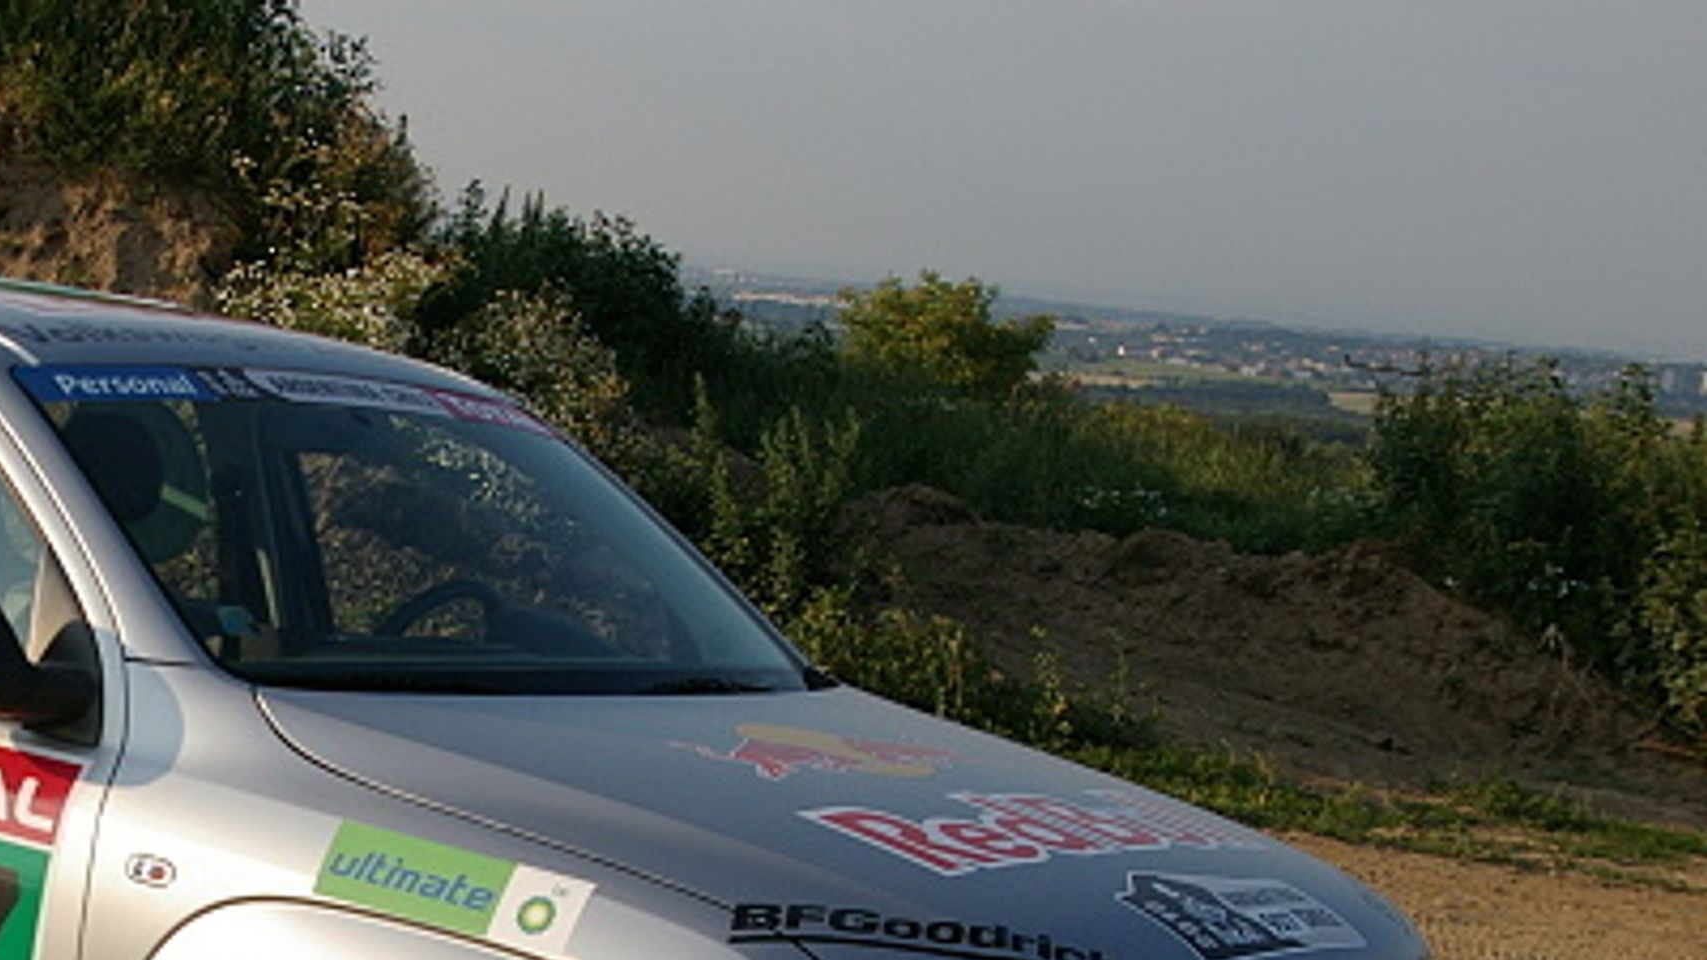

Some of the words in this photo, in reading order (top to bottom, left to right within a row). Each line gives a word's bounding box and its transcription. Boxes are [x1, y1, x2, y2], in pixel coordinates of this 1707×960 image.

[53, 373, 198, 395] Personal
[812, 794, 1106, 870] Red
[328, 849, 497, 911] ultimate
